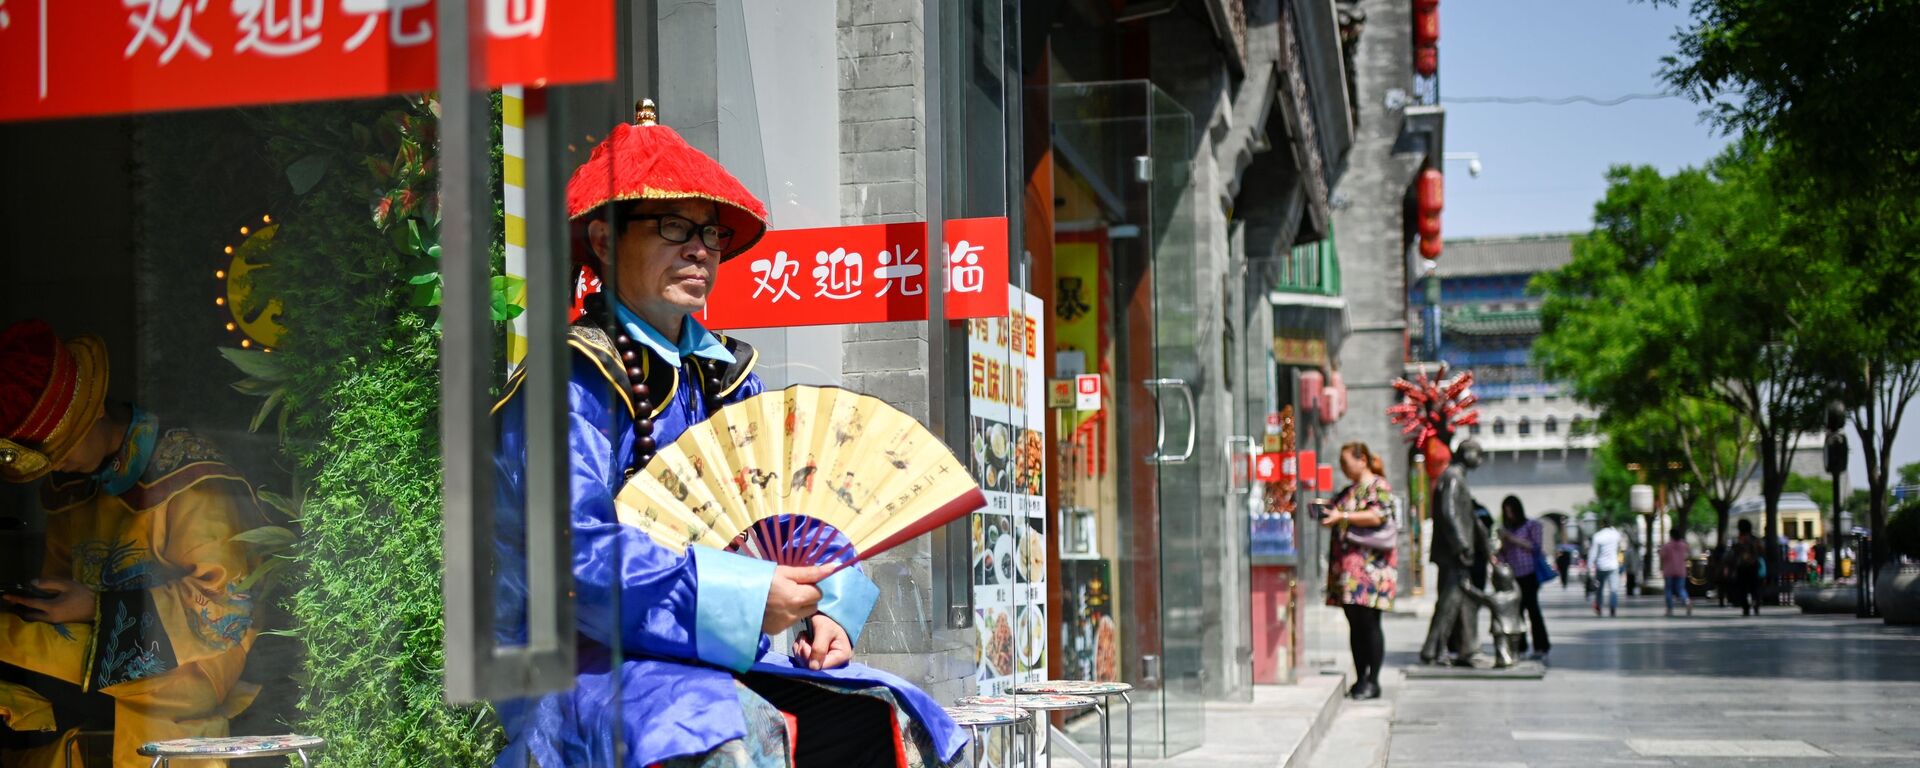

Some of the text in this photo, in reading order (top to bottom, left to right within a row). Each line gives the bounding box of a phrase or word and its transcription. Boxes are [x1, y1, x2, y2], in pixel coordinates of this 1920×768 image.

[122, 0, 547, 66] 欢迎光
[750, 239, 985, 303] 欢迎光临
